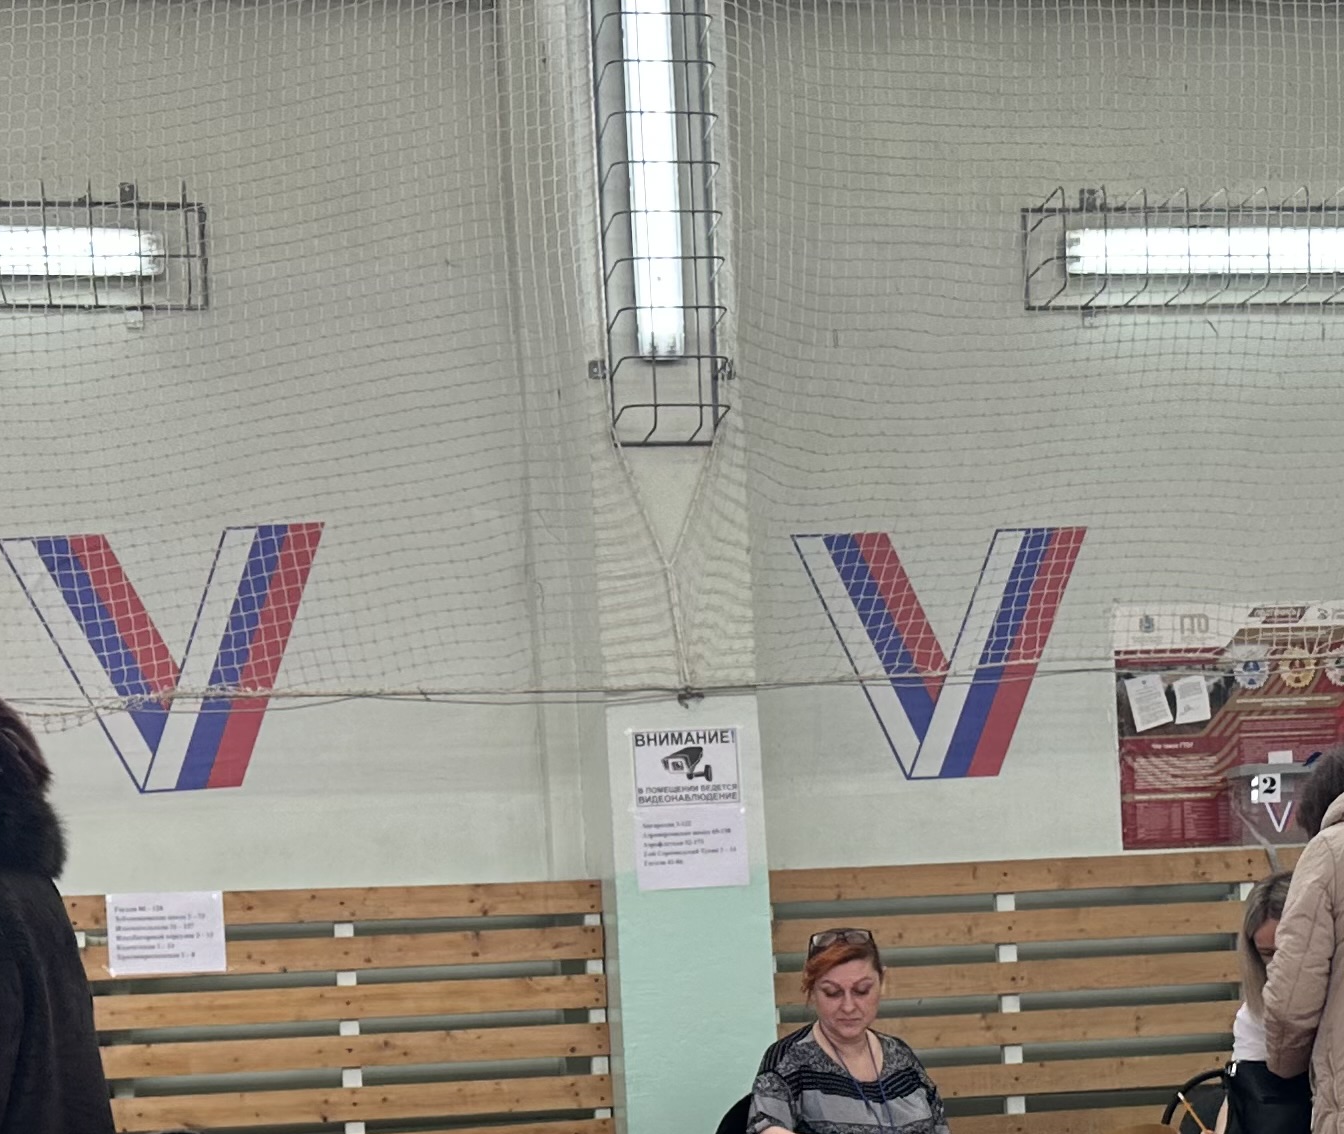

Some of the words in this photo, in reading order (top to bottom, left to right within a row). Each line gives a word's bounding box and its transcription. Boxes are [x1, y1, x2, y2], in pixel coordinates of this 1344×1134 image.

[634, 729, 736, 747] ВНИМАНИЕ!
[645, 785, 699, 794] ПОМЕЩЕНИИ
[1262, 776, 1277, 794] 2
[638, 792, 738, 804] ВИДЕОНАБЛЮДЕНИЕ
